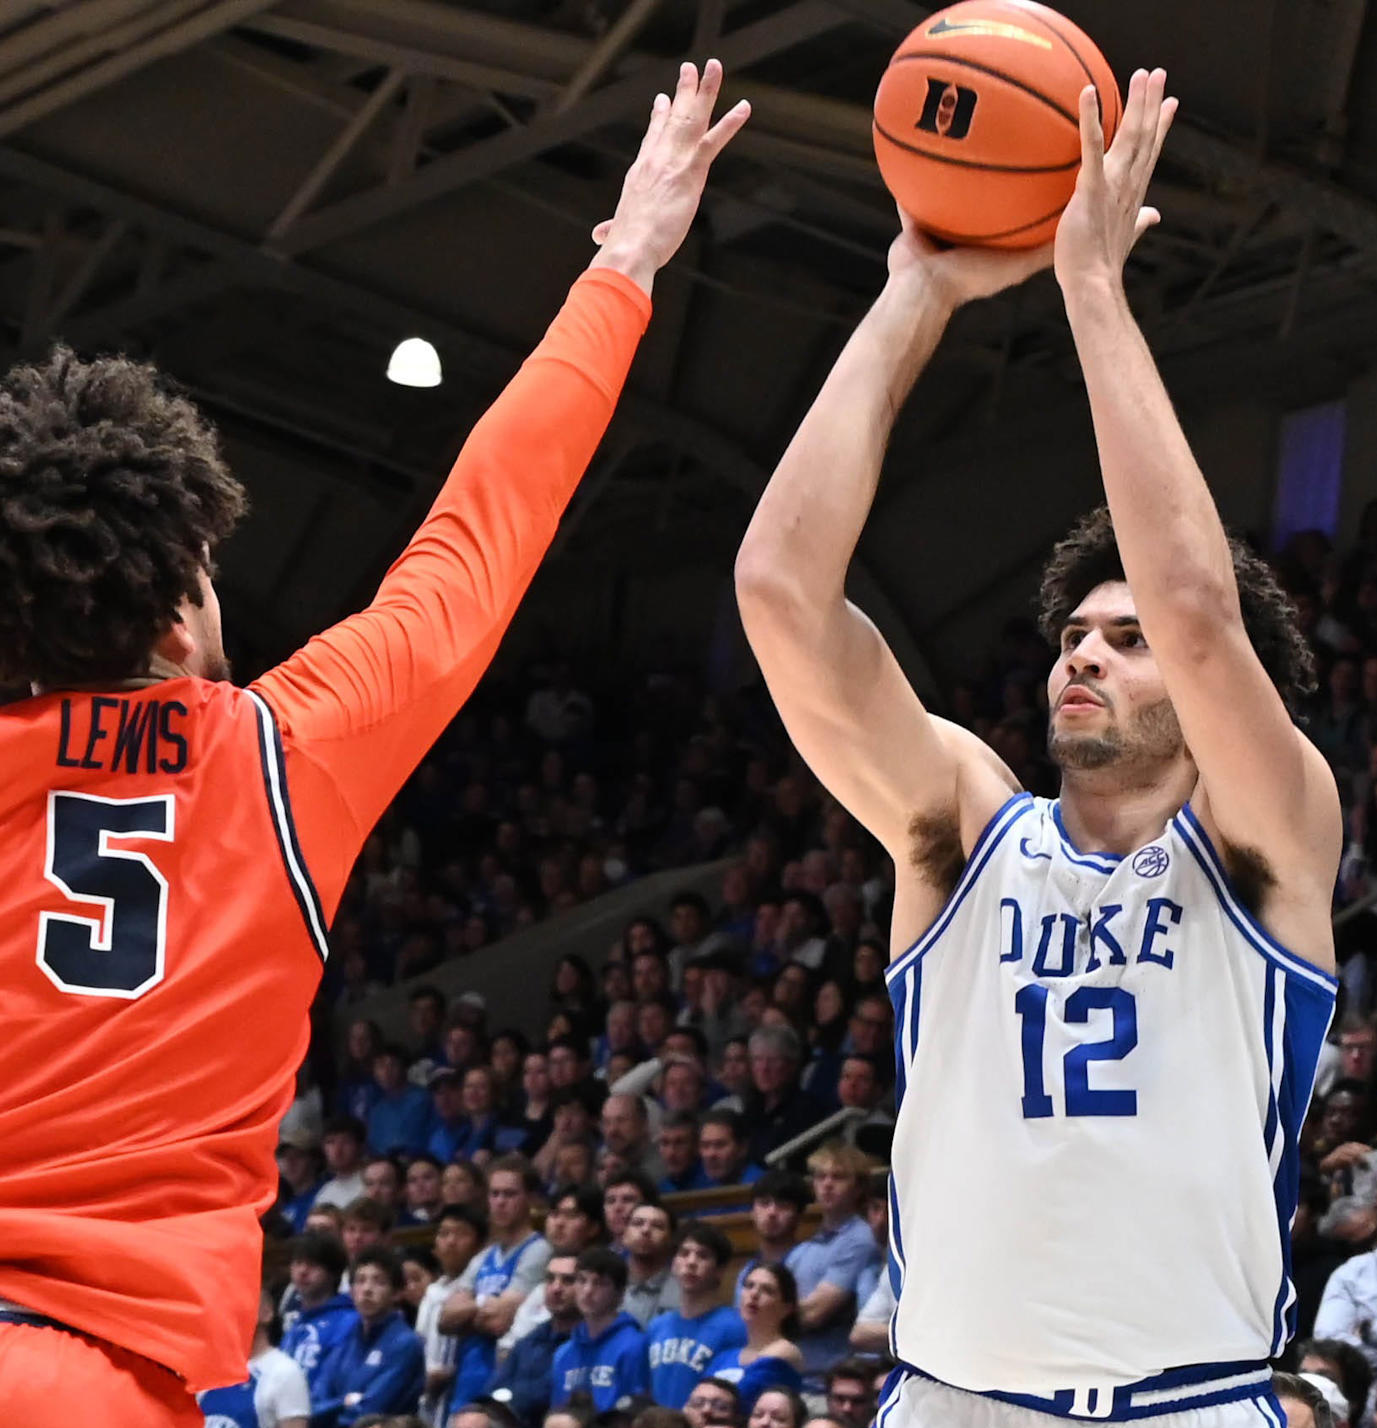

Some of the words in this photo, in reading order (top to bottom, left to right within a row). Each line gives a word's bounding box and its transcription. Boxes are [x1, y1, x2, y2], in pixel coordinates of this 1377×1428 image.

[56, 697, 188, 775] LEWIS
[35, 790, 176, 1000] 5
[999, 896, 1184, 978] DUKE
[1015, 984, 1138, 1119] 12
